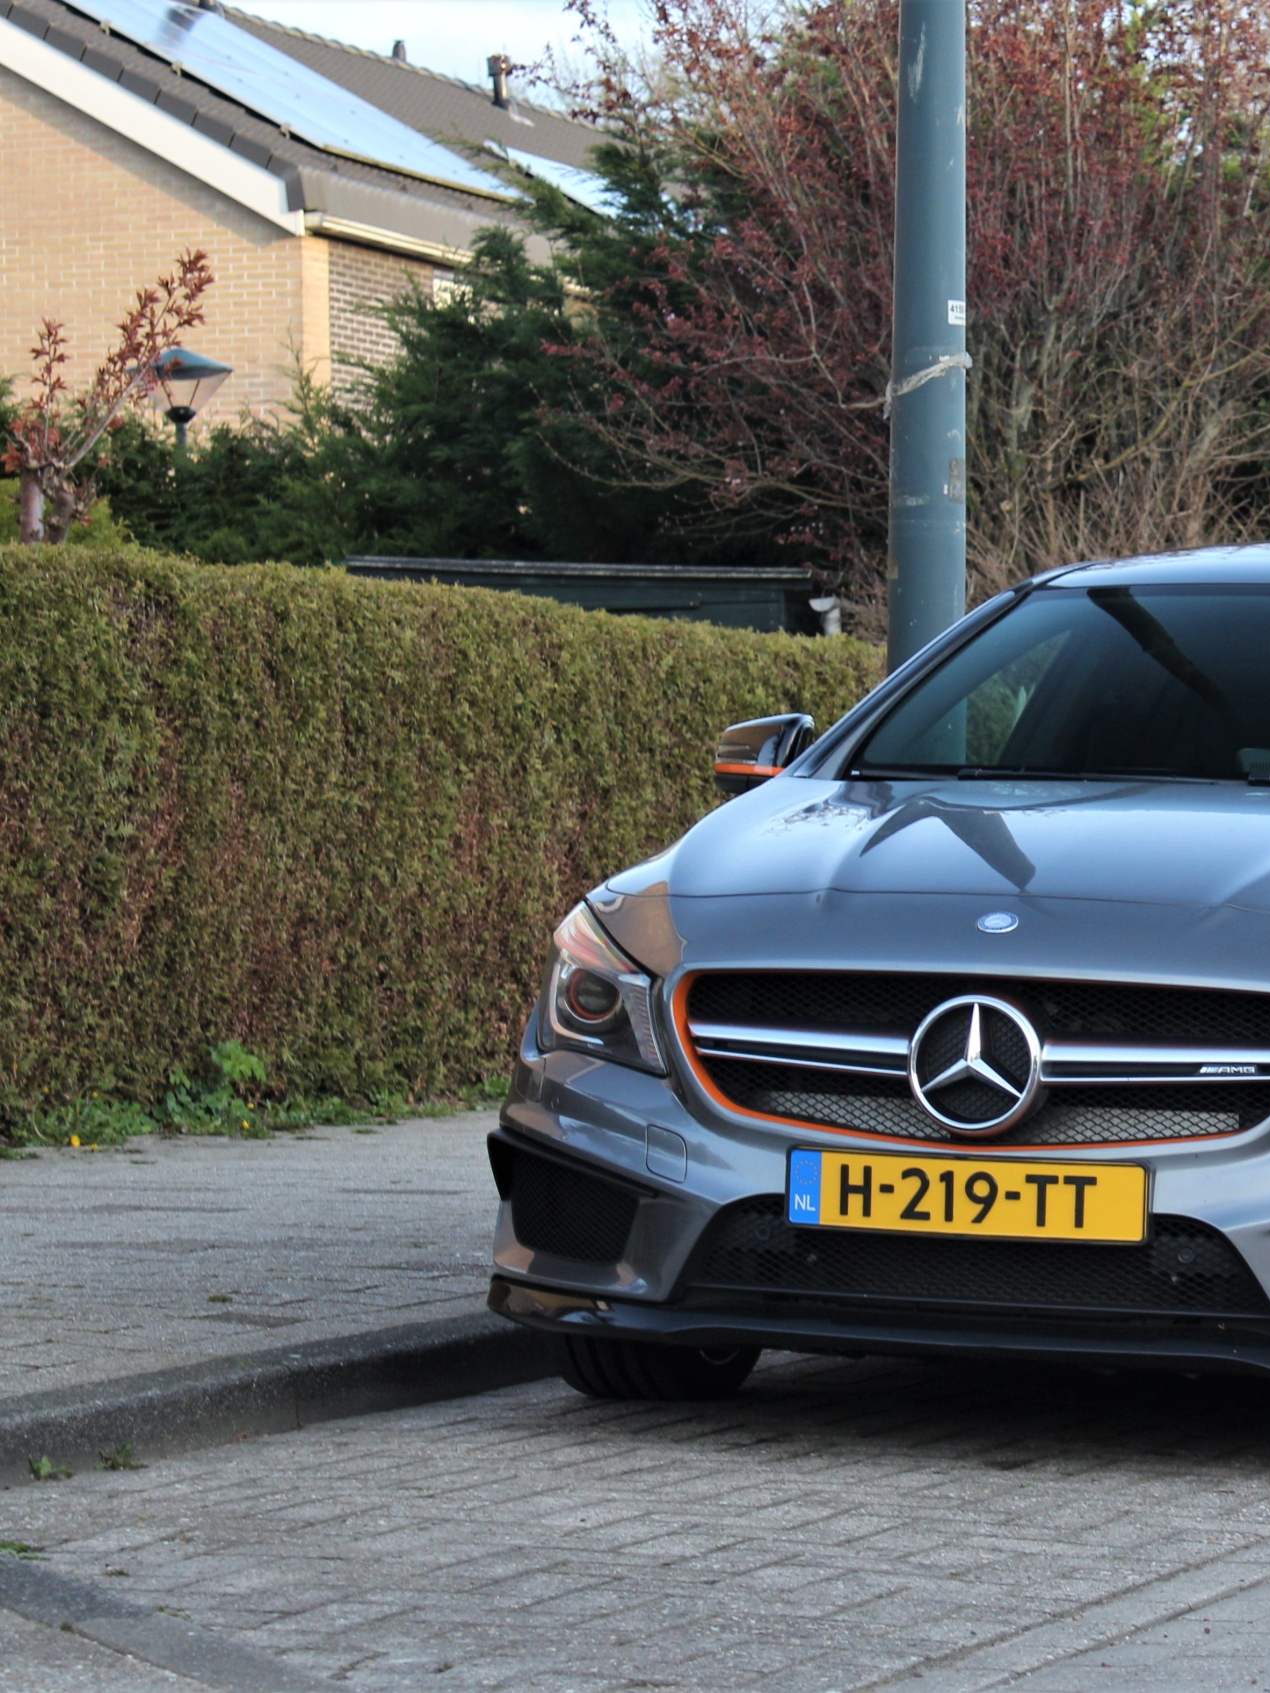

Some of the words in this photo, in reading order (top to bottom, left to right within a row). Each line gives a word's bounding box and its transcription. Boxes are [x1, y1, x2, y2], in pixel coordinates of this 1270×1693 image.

[1217, 1066, 1255, 1074] AMG
[794, 1193, 817, 1212] NL
[838, 1163, 1098, 1229] H-219-TT
